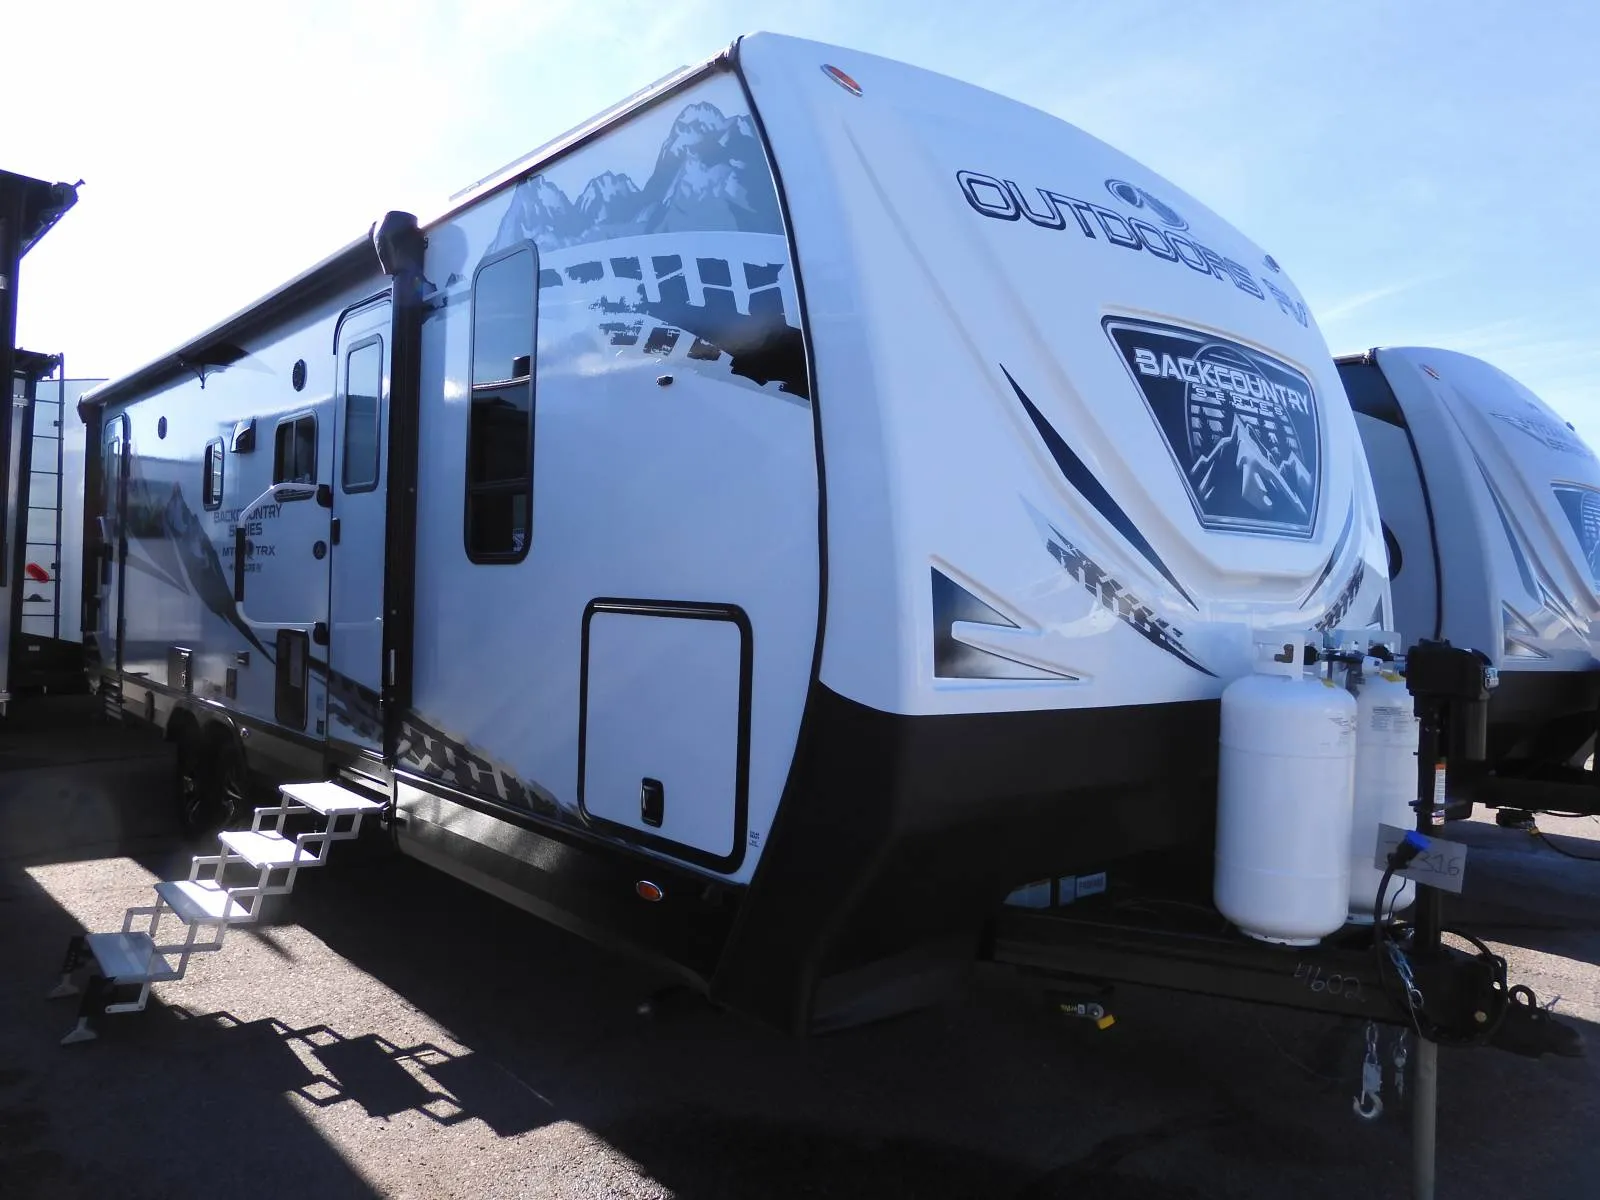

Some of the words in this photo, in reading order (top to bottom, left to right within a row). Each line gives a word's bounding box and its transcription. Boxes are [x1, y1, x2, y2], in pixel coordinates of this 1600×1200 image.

[956, 169, 1265, 301] OUTDOORS
[1134, 347, 1310, 415] BACKCOUNTRY
[1195, 386, 1284, 416] SERIES
[214, 503, 283, 523] BACKUNTRY
[229, 522, 263, 538] SIES
[255, 545, 276, 556] TRX
